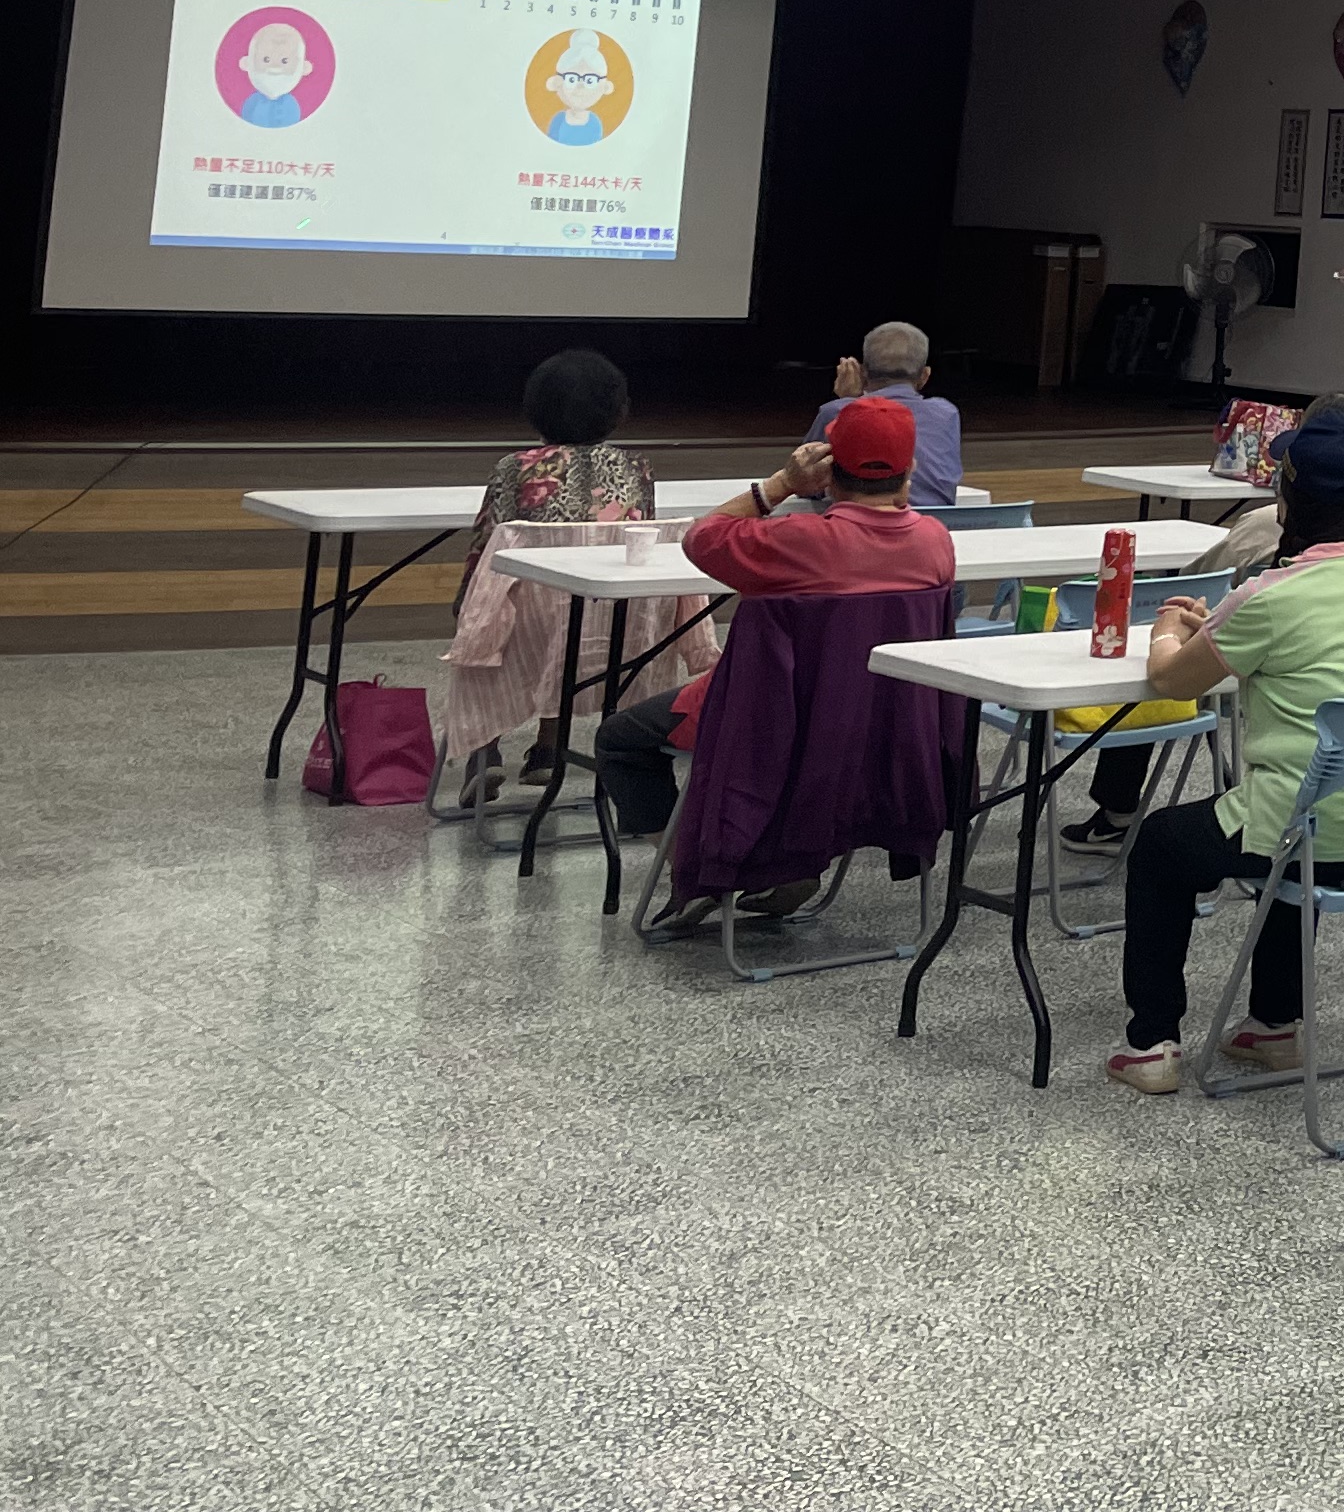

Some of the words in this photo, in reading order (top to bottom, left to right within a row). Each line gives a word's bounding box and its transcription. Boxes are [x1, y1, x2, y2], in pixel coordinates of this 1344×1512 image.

[503, 0, 511, 11] 2
[526, 2, 534, 13] 3
[546, 4, 554, 14] 4
[570, 6, 577, 17] 5
[590, 7, 597, 18] 6
[610, 9, 618, 20] 7
[629, 11, 637, 22] 8
[651, 13, 659, 24] 9
[671, 15, 684, 26] 10
